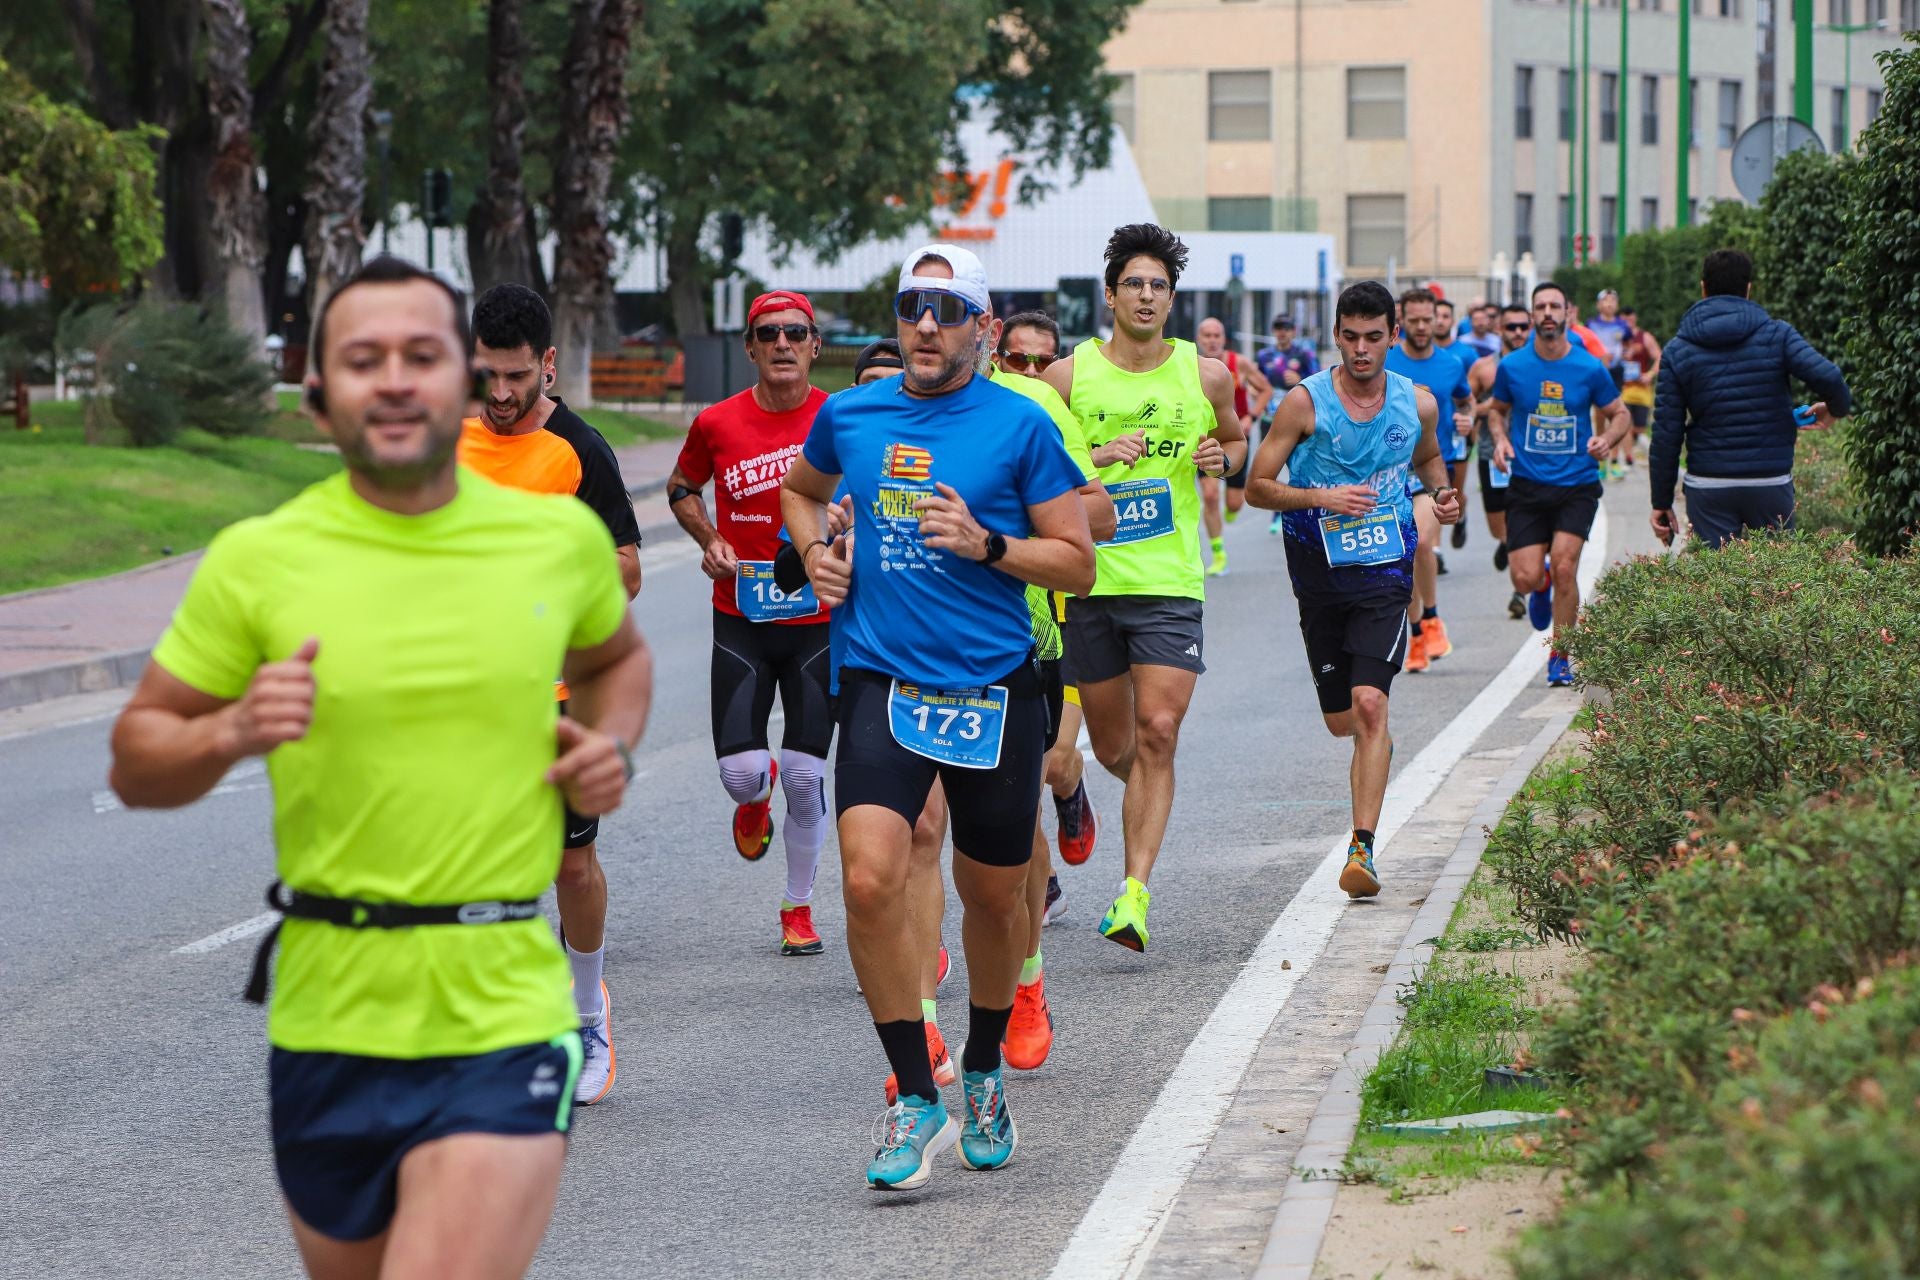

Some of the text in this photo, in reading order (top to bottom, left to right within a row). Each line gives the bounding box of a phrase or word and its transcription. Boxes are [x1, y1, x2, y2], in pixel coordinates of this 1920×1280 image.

[1389, 433, 1403, 442] SR
[1536, 429, 1568, 443] 634
[743, 481, 780, 497] CARRERA
[1341, 526, 1388, 551] 558
[966, 699, 1001, 711] VALENCIA
[912, 705, 982, 740] 173
[932, 738, 953, 747] SOLA
